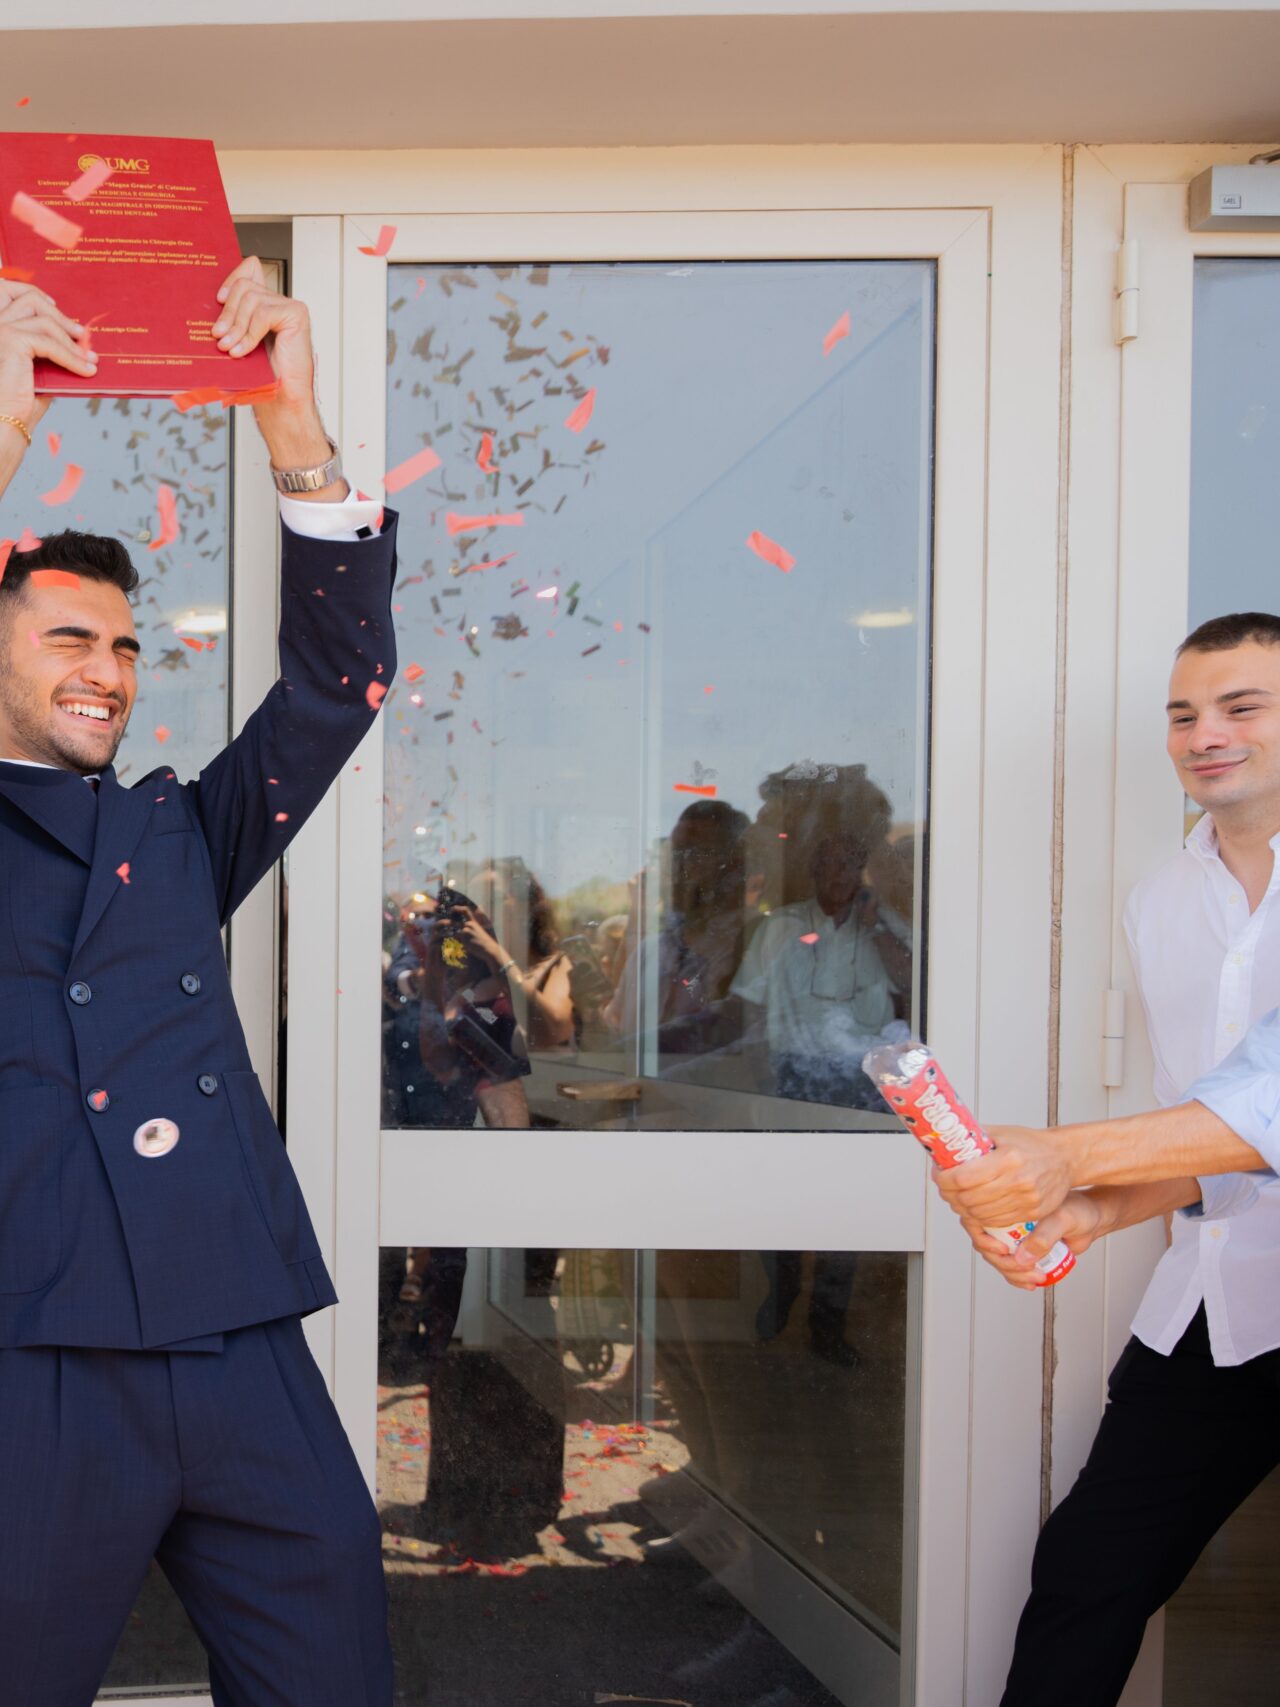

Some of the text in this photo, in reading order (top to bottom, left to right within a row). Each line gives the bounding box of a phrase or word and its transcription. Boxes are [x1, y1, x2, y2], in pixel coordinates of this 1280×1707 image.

[105, 157, 150, 170] UMG
[98, 189, 132, 197] MEDICINA
[138, 191, 176, 199] CHIRURGIA
